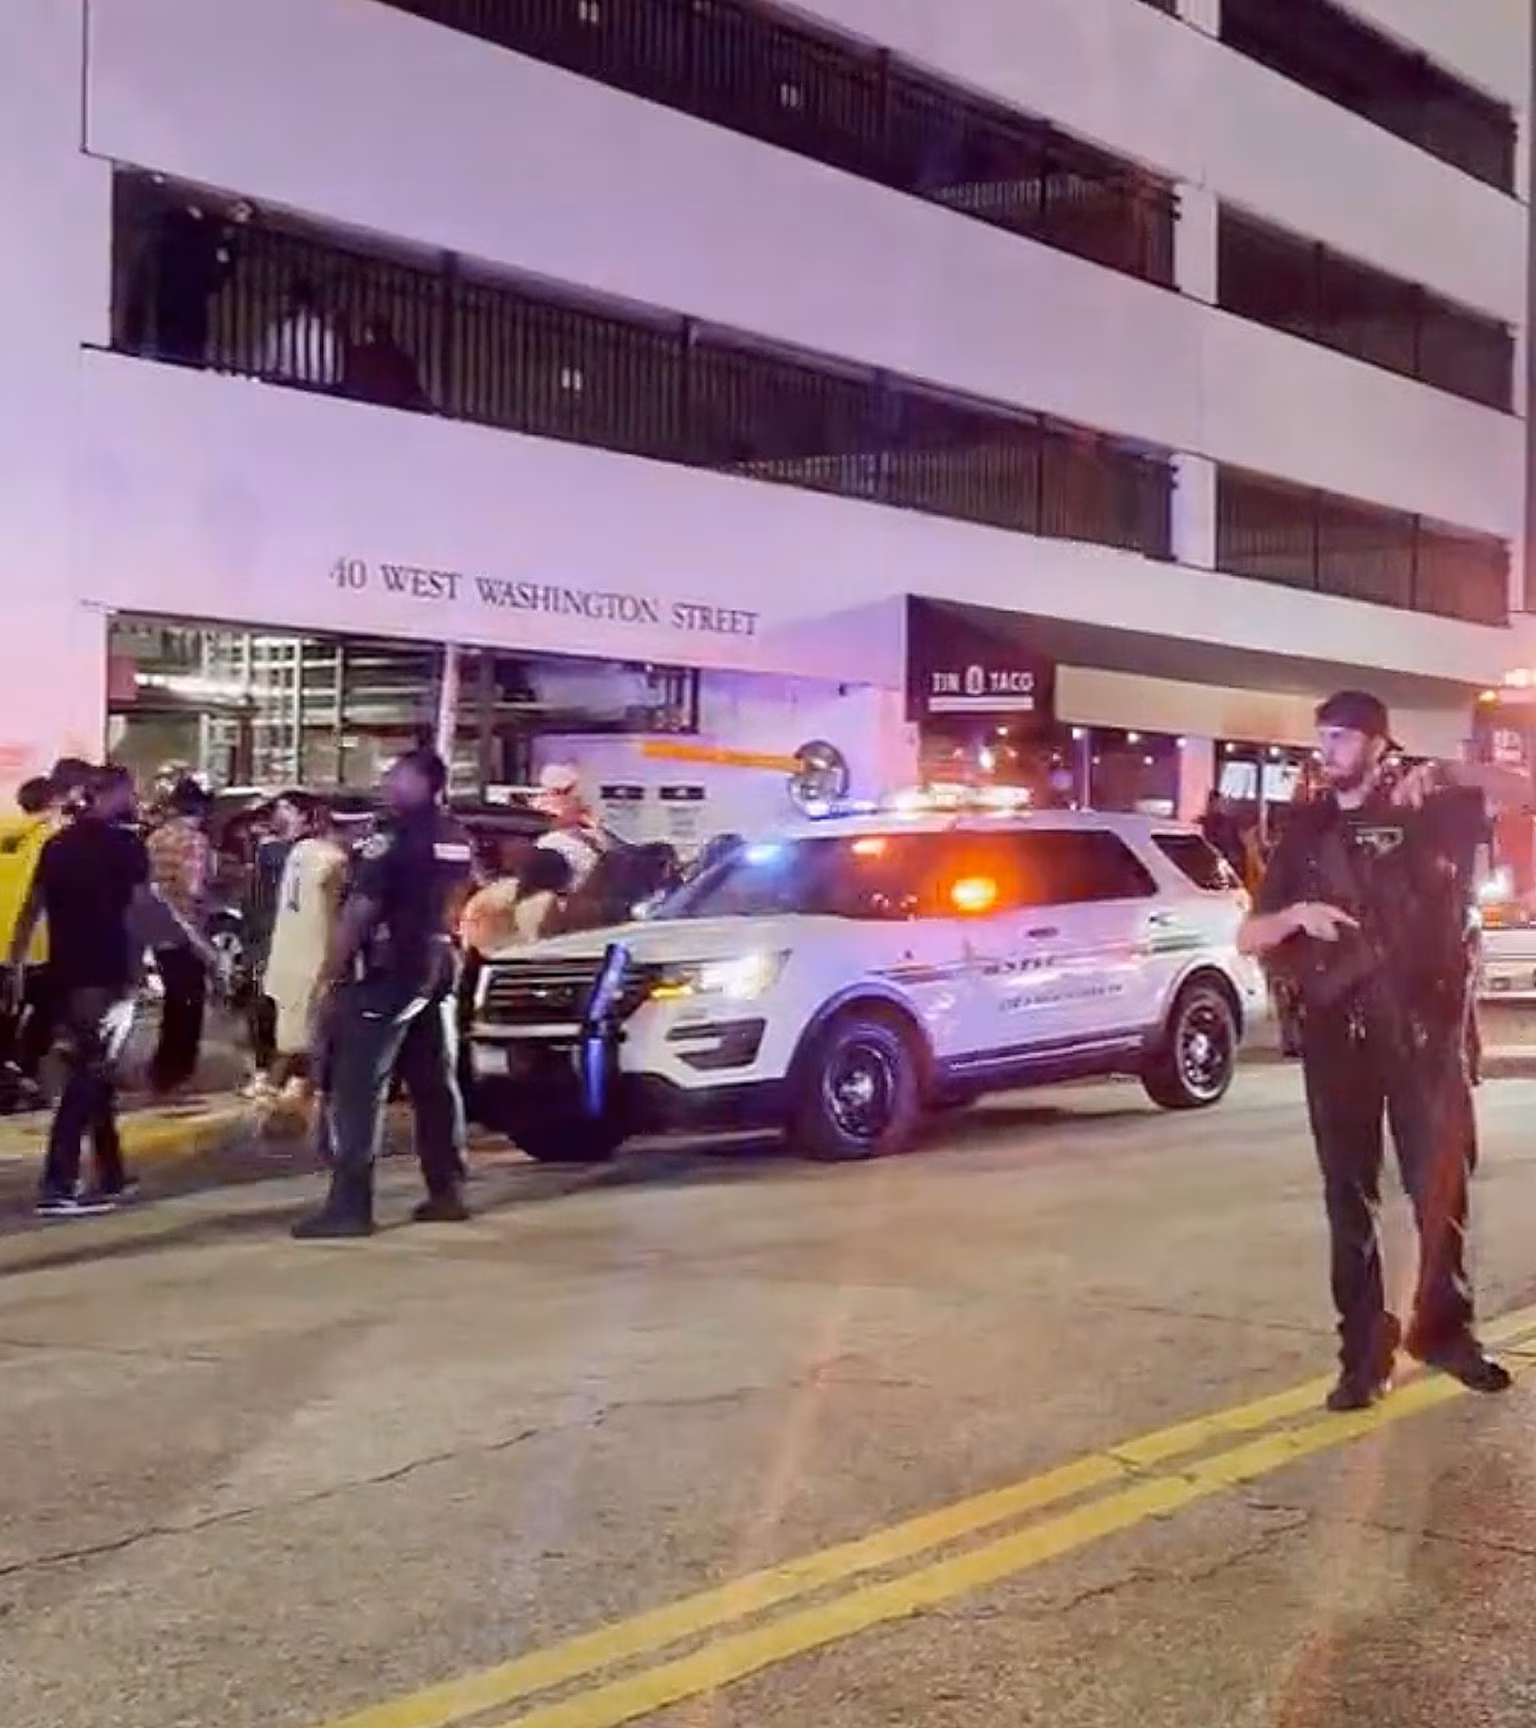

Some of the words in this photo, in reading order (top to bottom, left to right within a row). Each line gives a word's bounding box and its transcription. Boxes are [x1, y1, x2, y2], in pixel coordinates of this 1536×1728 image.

[331, 556, 367, 589] 40
[380, 563, 462, 600] WEST
[475, 577, 659, 623] WASHINGTON
[671, 602, 760, 636] STREET
[989, 671, 1033, 692] TACO
